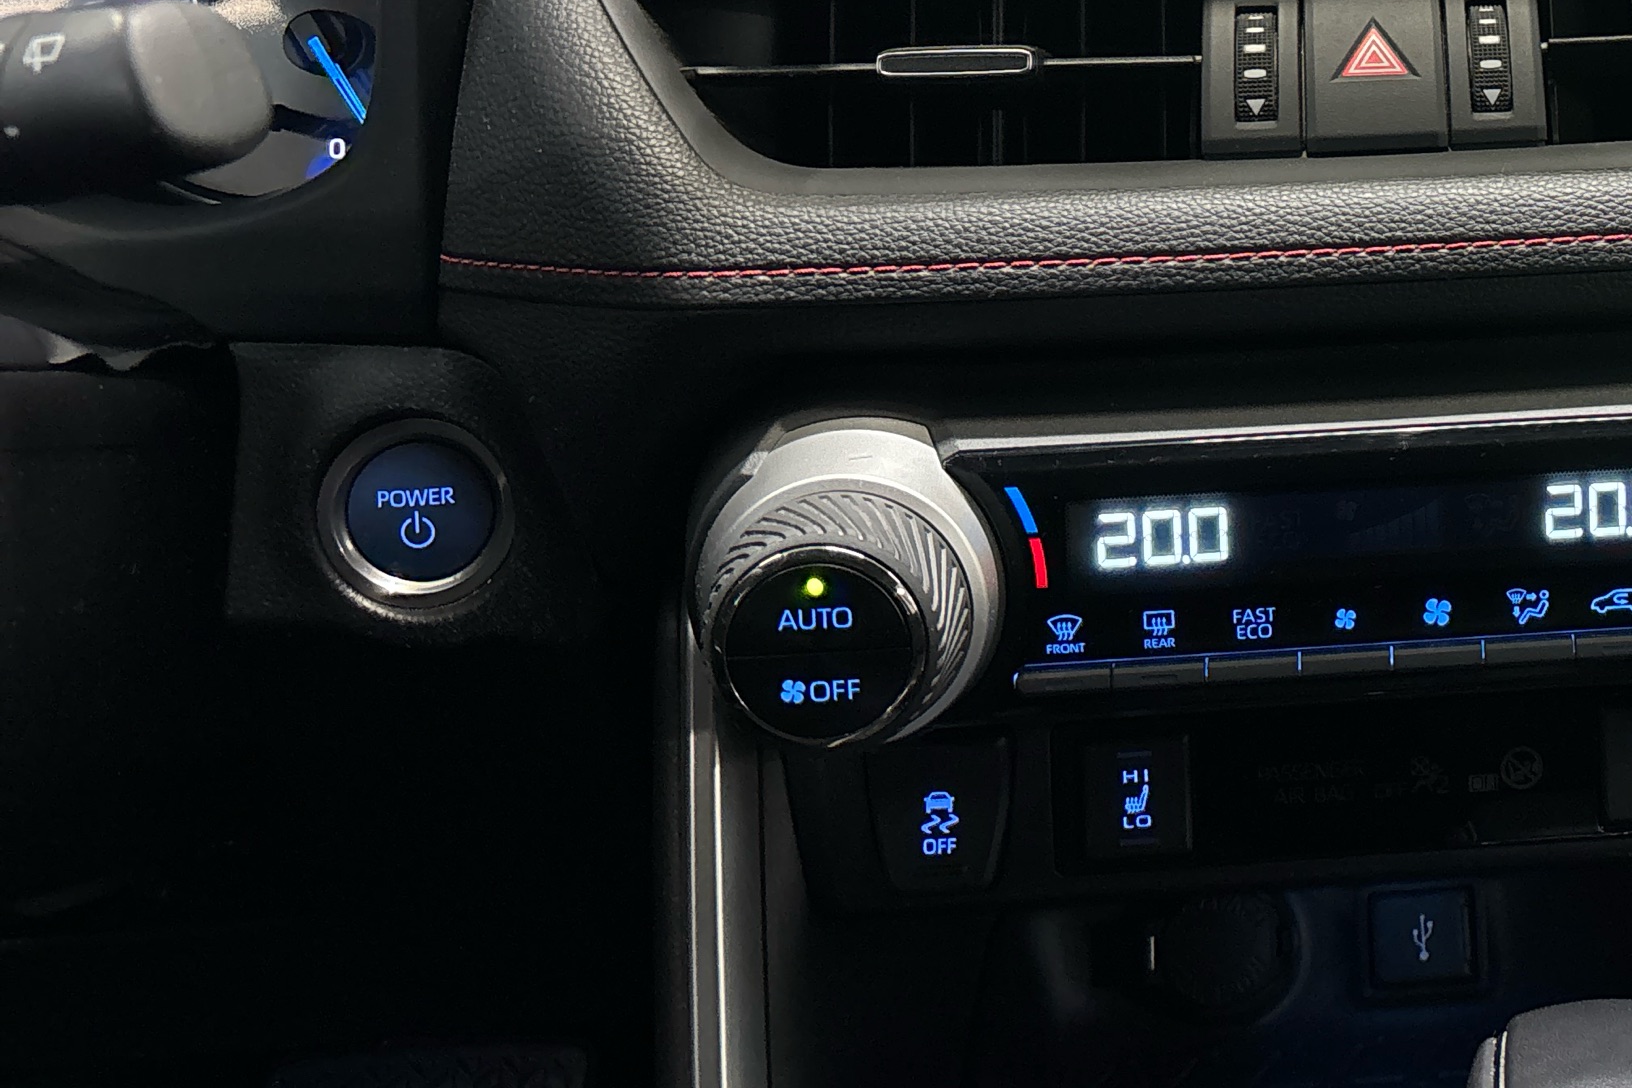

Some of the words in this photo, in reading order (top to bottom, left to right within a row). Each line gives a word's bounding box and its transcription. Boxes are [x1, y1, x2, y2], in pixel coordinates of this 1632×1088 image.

[376, 486, 456, 509] POWER
[1094, 503, 1229, 571] 20.0
[777, 606, 853, 631] AUTO
[1232, 606, 1276, 623] FAST
[1236, 623, 1273, 641] ECO
[1045, 641, 1086, 655] FRONT
[1143, 636, 1176, 649] REAR
[809, 678, 860, 703] OFF
[1122, 769, 1149, 784] HI
[1122, 814, 1152, 829] LO
[922, 837, 957, 855] OFF
